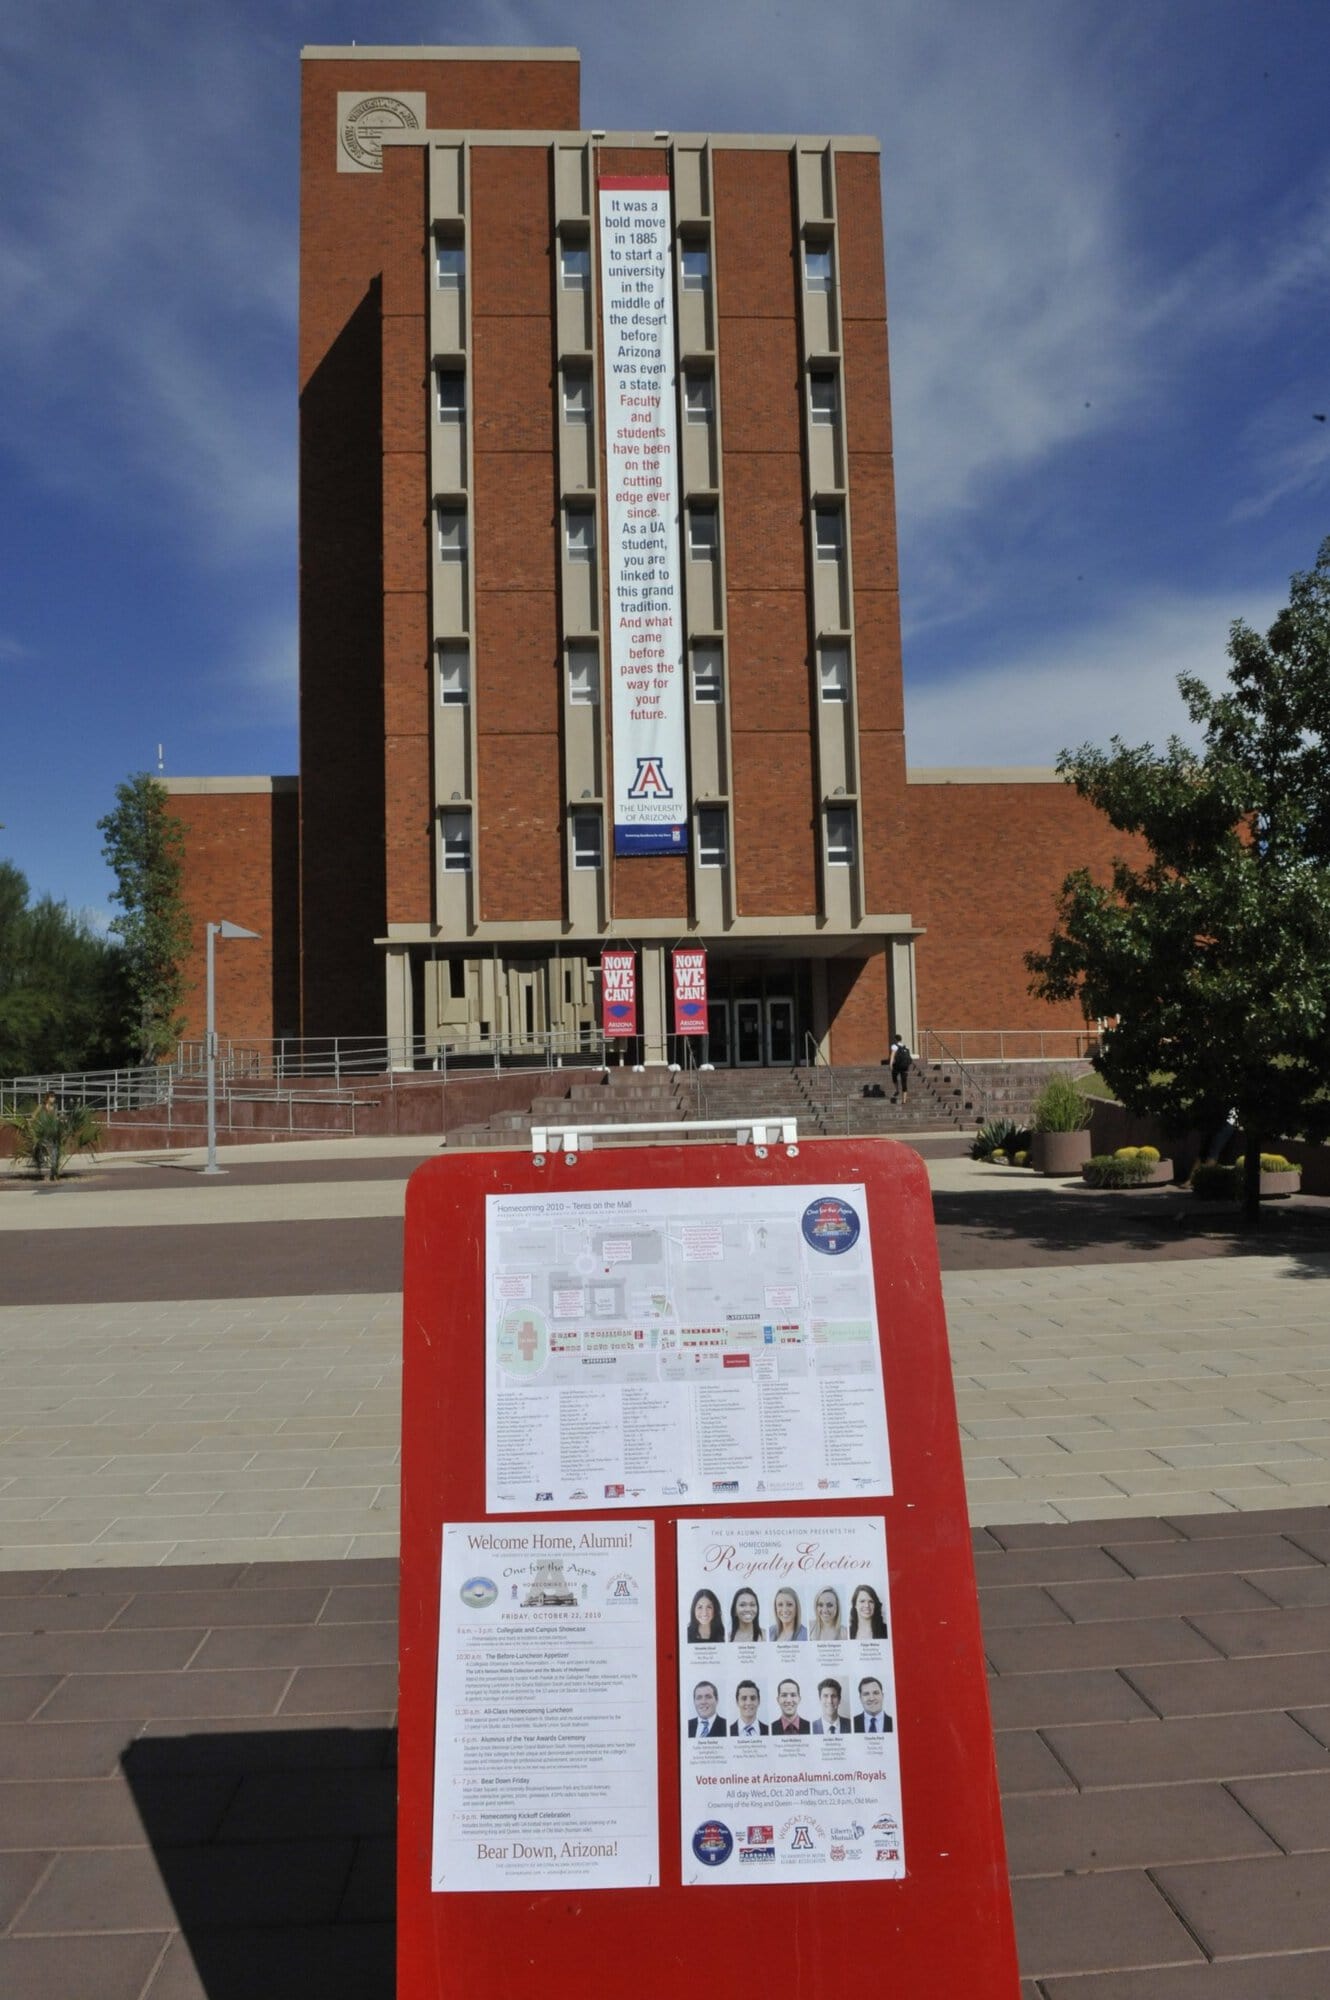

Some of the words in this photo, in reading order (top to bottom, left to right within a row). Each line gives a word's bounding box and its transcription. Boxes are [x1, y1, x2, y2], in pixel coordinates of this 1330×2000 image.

[612, 200, 620, 211] It
[624, 203, 647, 211] was
[651, 203, 658, 211] a
[605, 216, 630, 228] bold
[635, 219, 666, 228] move
[615, 233, 625, 244] in
[630, 233, 657, 244] 1885
[611, 250, 621, 260] to
[626, 249, 652, 260] start
[656, 252, 662, 260] a
[609, 266, 665, 279] university
[621, 282, 632, 292] in
[636, 281, 654, 293] the
[611, 297, 650, 308] middle
[654, 297, 665, 309] of
[610, 314, 628, 324] the
[631, 314, 667, 326] desert
[621, 329, 657, 342] before
[618, 346, 661, 358] Arizona
[613, 364, 637, 373] was
[640, 364, 666, 374] even
[620, 381, 626, 389] a
[630, 379, 661, 390] state.
[620, 395, 661, 408] Faculty
[631, 412, 651, 423] and
[617, 426, 666, 439] students
[613, 443, 640, 454] have
[644, 444, 670, 454] been
[625, 461, 638, 470] on
[643, 460, 660, 470] the
[623, 476, 662, 487] cutting
[616, 491, 643, 505] edge
[647, 492, 670, 503] ever
[627, 507, 660, 518] since.
[623, 523, 636, 534] As
[640, 525, 646, 534] a
[650, 522, 665, 533] UA
[622, 539, 668, 550] student,
[624, 557, 644, 568] you
[648, 556, 665, 565] are
[621, 569, 655, 581] linked
[659, 570, 669, 580] to
[617, 586, 638, 597] this
[642, 585, 673, 599] grand
[621, 600, 671, 612] tradition.
[619, 617, 641, 628] And
[645, 616, 672, 627] what
[631, 634, 662, 643] came
[629, 647, 664, 659] before
[620, 665, 653, 676] paves
[657, 662, 674, 673] the
[627, 681, 650, 691] way
[653, 678, 668, 688] for
[636, 696, 660, 707] your
[630, 709, 667, 720] future.
[628, 757, 673, 799] A
[620, 804, 634, 812] THE
[640, 813, 676, 821] ARIZONA
[605, 957, 632, 971] NOW
[676, 955, 703, 969] NOW
[604, 970, 633, 989] WE
[675, 967, 704, 986] WE
[605, 987, 633, 1002] CAN!
[676, 987, 704, 1000] CAN!
[498, 1204, 544, 1213] Homecoming
[546, 1203, 564, 1211] 2010
[573, 1202, 591, 1210] Tents
[468, 1534, 528, 1550] Welcome
[532, 1534, 576, 1549] Home,
[579, 1533, 633, 1548] Alumni!
[704, 1544, 794, 1579] Royalty
[796, 1543, 872, 1571] Election
[503, 1567, 525, 1578] One
[529, 1562, 545, 1575] for
[548, 1562, 564, 1572] the
[567, 1564, 596, 1577] Ages
[502, 1612, 530, 1620] FRIDAY,
[571, 1612, 582, 1620] 22,
[536, 1626, 557, 1634] Campus
[509, 1707, 544, 1715] Homecoming
[512, 1777, 530, 1785] Friday
[696, 1775, 717, 1785] Vote
[719, 1774, 749, 1784] online
[751, 1775, 760, 1783] at
[763, 1770, 886, 1784] ArizonaAlumni.com/Royals
[727, 1790, 736, 1798] All
[737, 1789, 749, 1799] day
[751, 1789, 769, 1798] Wed.,
[771, 1789, 783, 1797] Oct.
[796, 1788, 808, 1796] and
[810, 1788, 831, 1796] Thurs.,
[848, 1787, 856, 1795] 21
[708, 1801, 733, 1809] Crowning
[779, 1815, 802, 1840] WILDCAT
[803, 1815, 816, 1826] FOR
[812, 1824, 825, 1839] LIFE
[872, 1822, 898, 1830] ARIZONA
[792, 1826, 813, 1849] A
[477, 1844, 509, 1859] Bear
[513, 1843, 557, 1860] Down,
[561, 1842, 618, 1858] Arizona!
